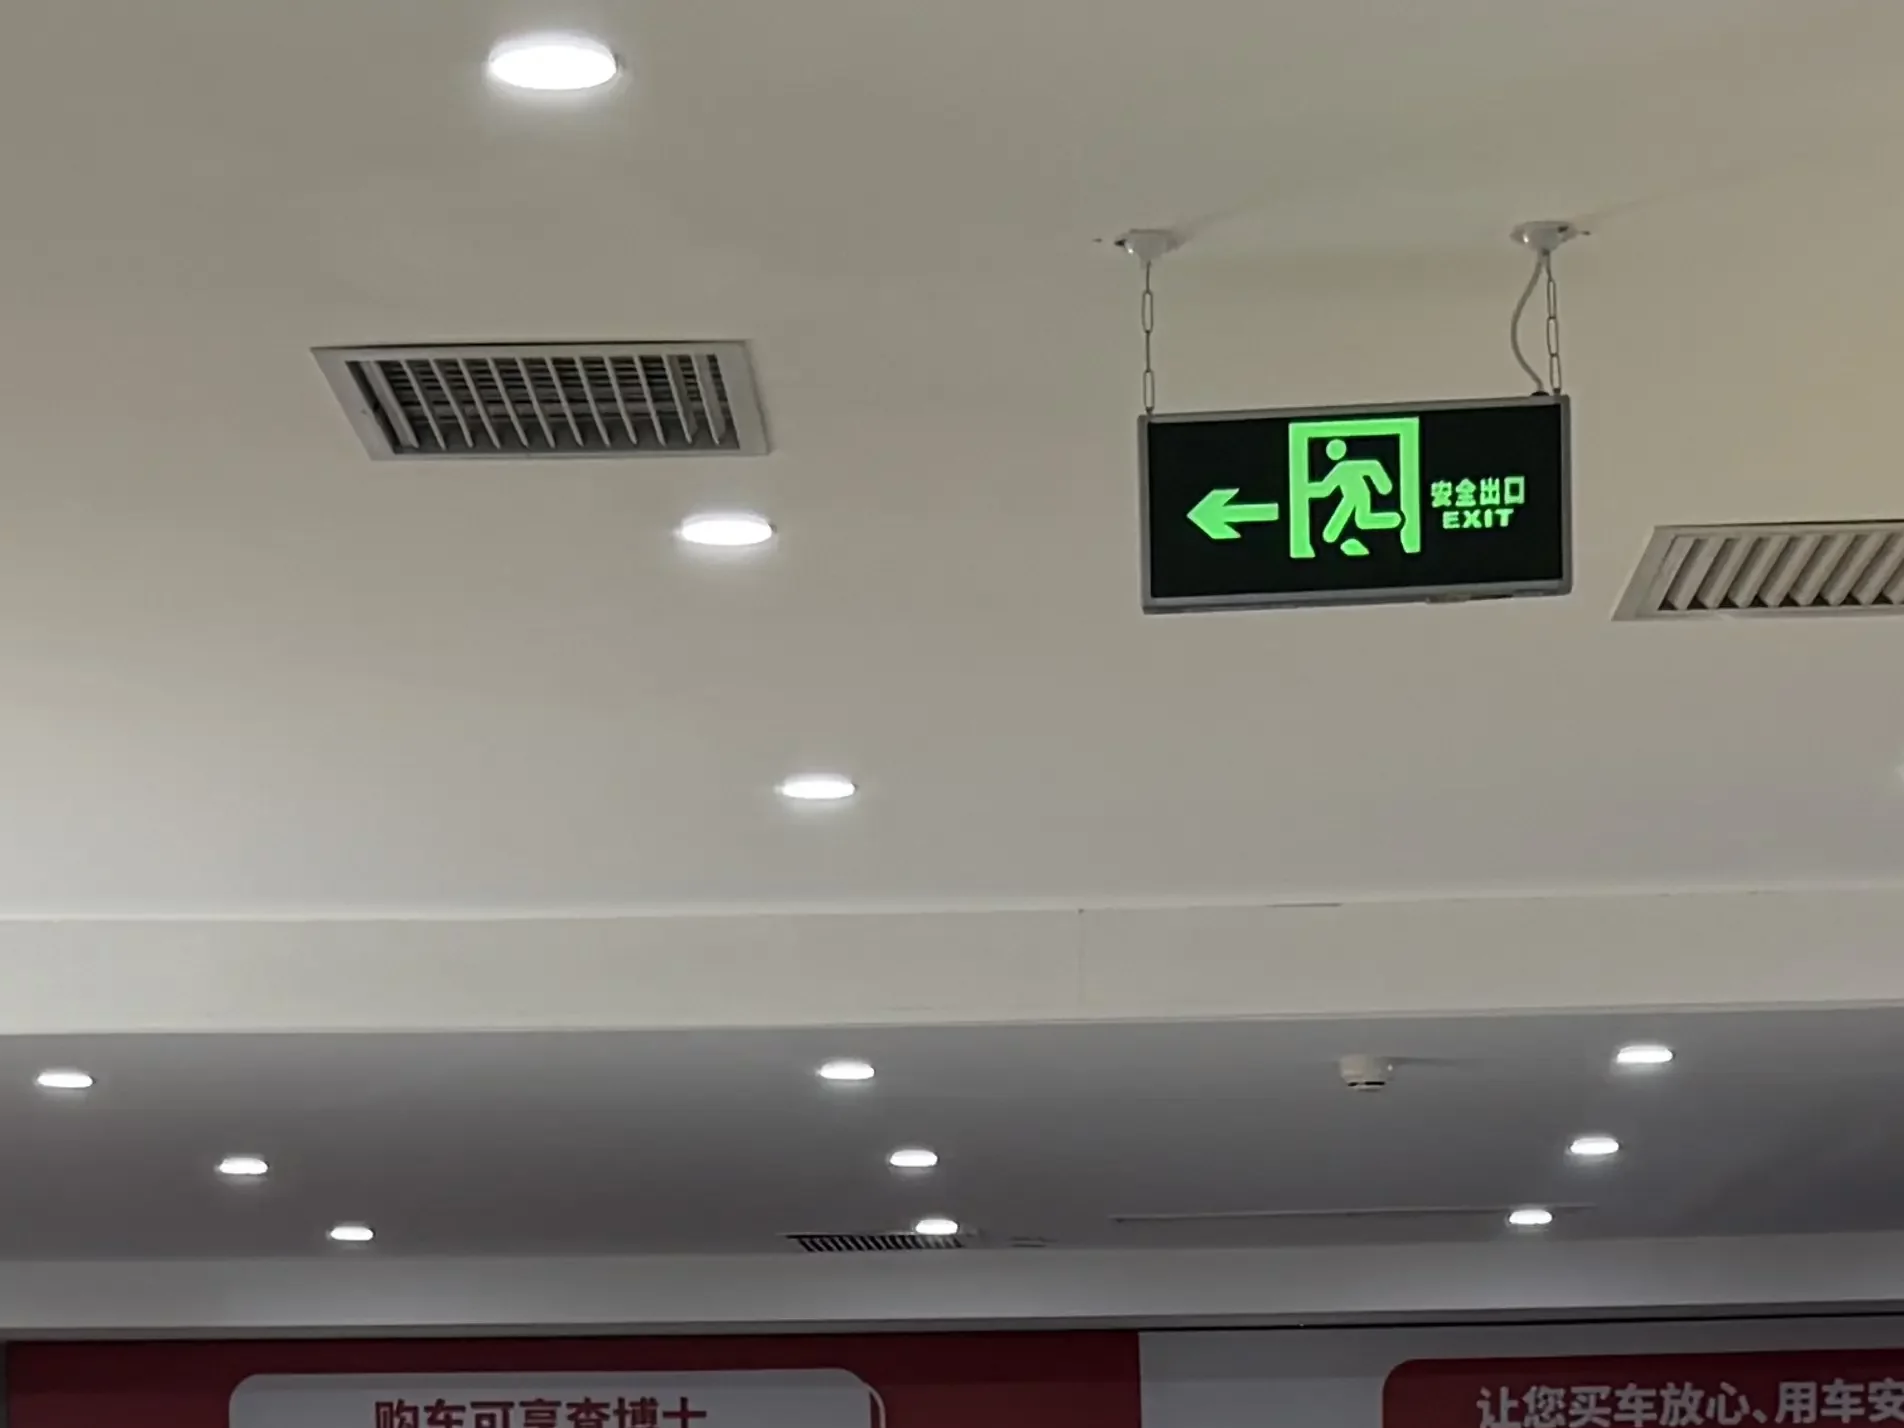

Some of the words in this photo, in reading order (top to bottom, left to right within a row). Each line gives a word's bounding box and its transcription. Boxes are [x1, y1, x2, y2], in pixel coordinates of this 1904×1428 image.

[1431, 476, 1525, 507] 安全出口
[1442, 508, 1515, 529] EXIT
